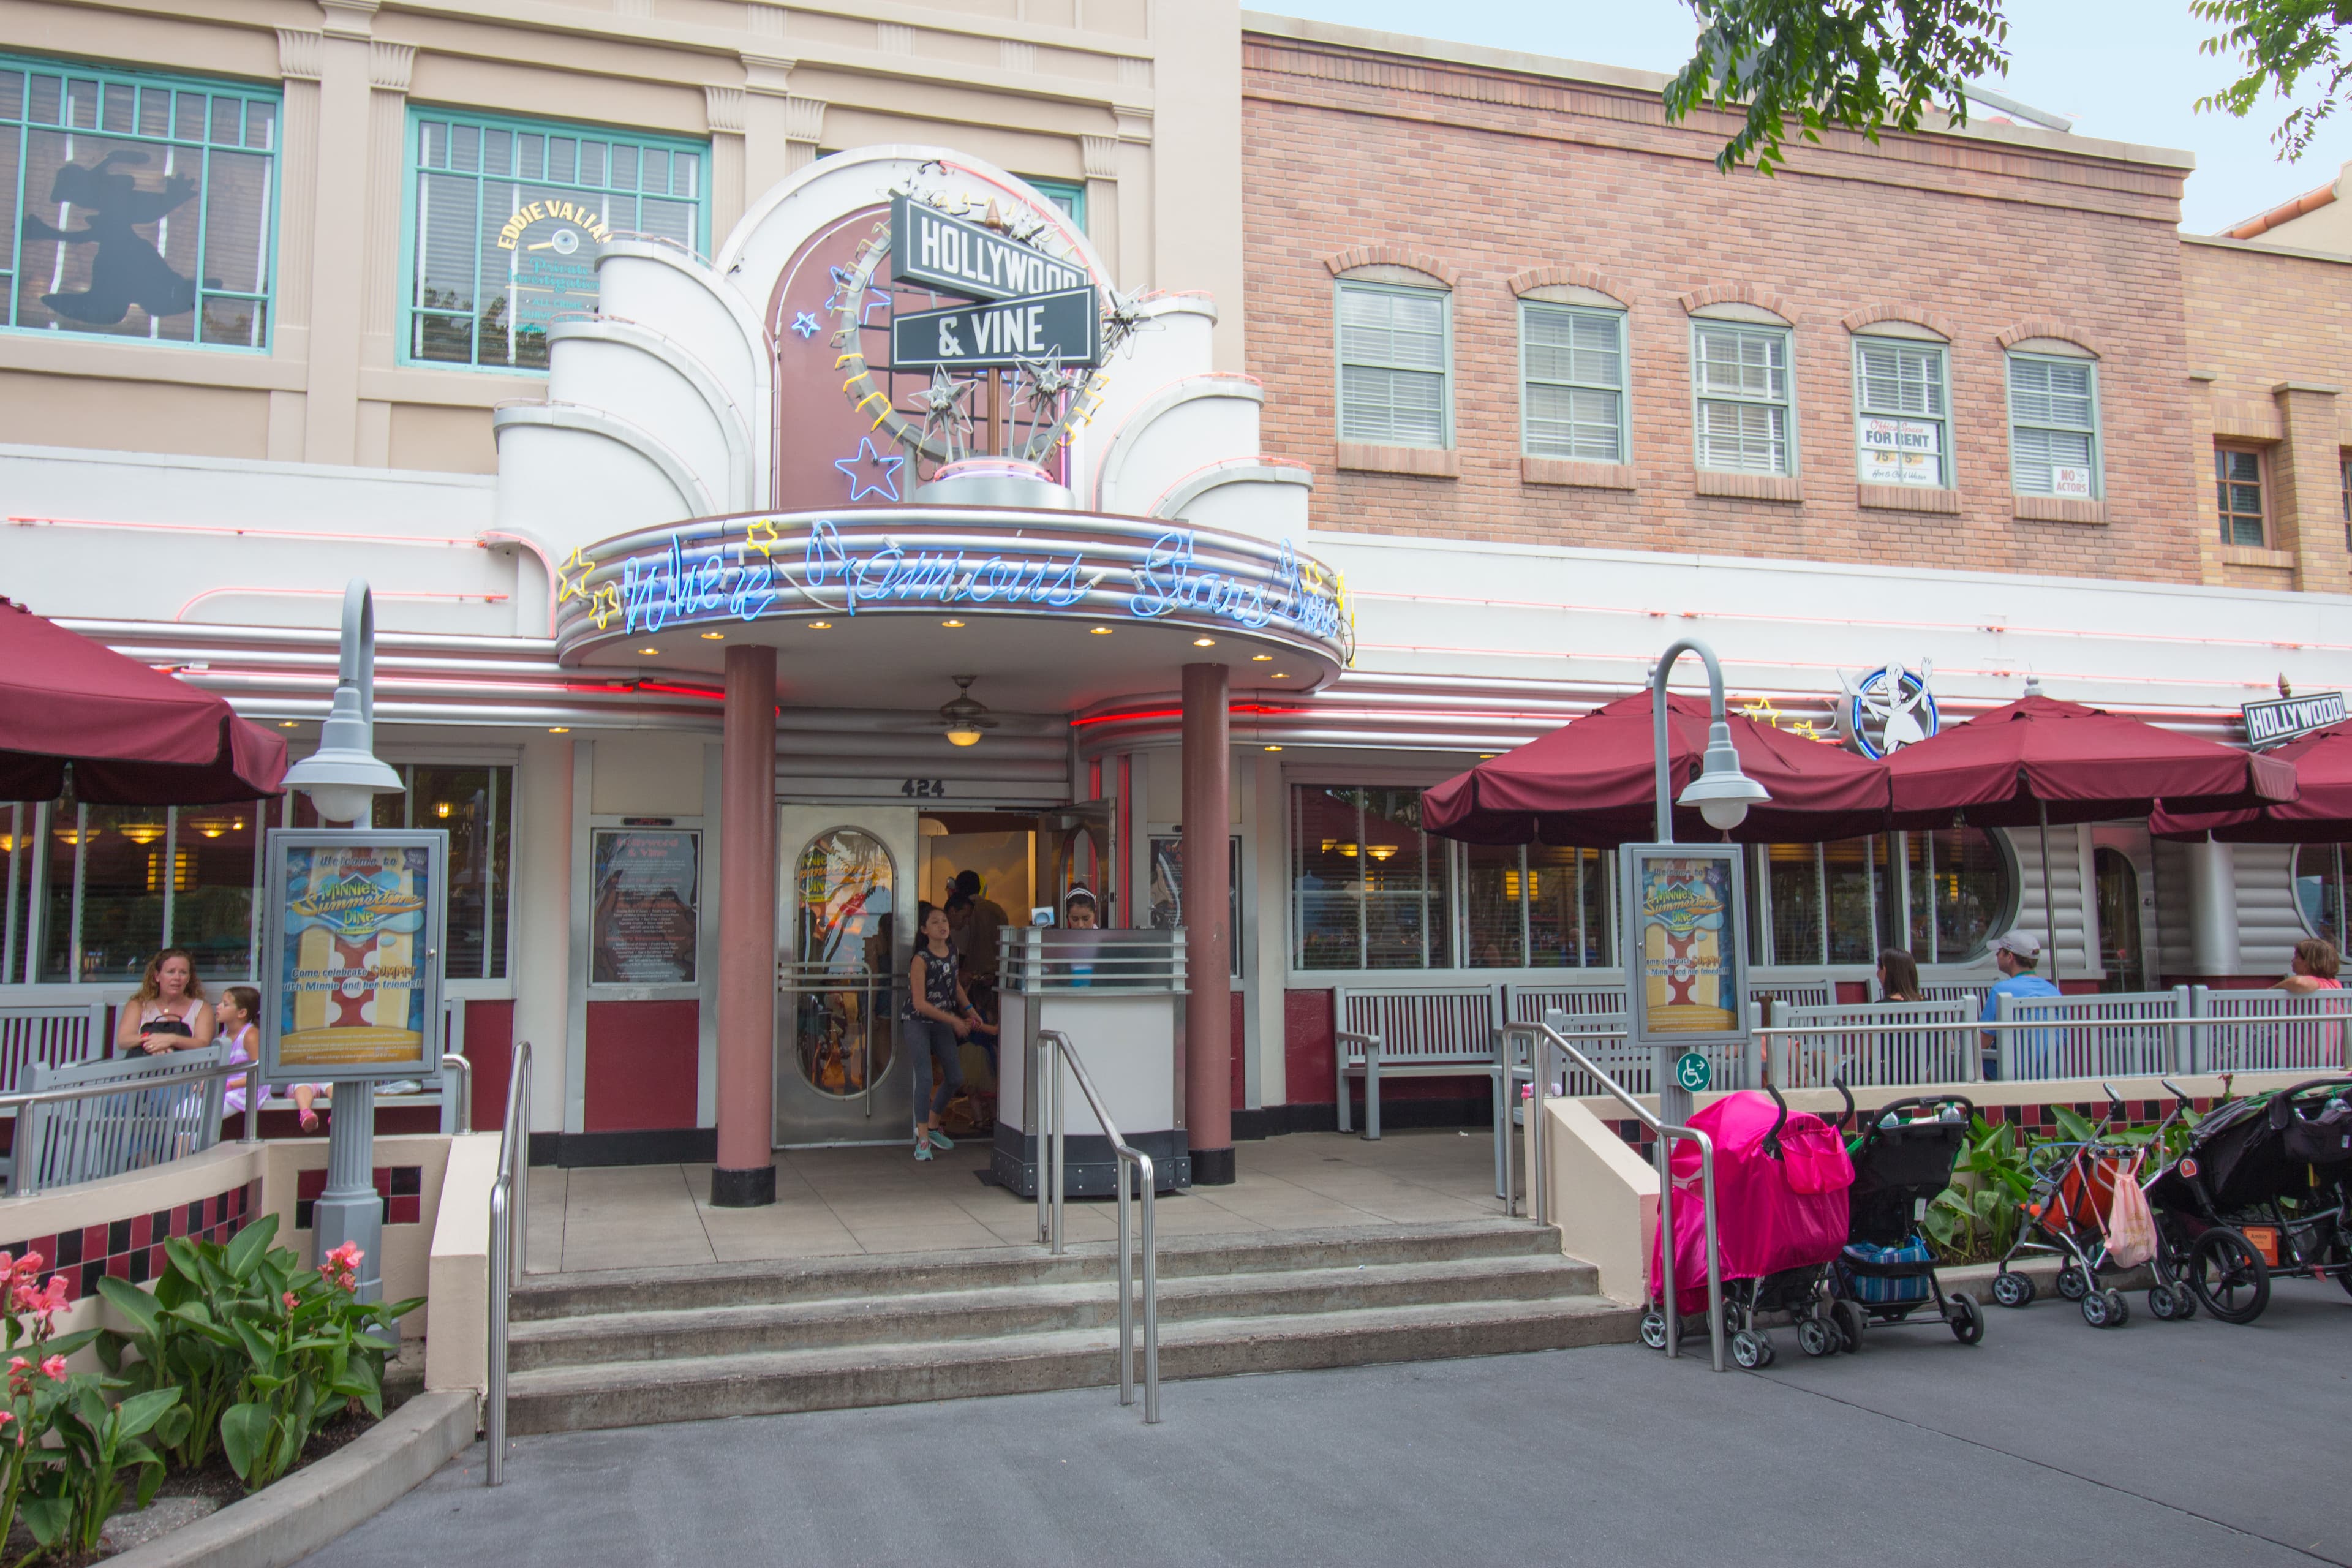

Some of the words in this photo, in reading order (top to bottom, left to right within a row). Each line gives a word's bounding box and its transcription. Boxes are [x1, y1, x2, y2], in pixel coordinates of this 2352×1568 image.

[497, 202, 545, 251] EDDIE
[545, 200, 613, 244] VALIA
[529, 257, 589, 275] Private
[554, 300, 582, 309] CRIME
[938, 317, 965, 356] &
[971, 306, 1044, 355] VINE
[1866, 430, 1891, 445] FOR
[1895, 432, 1929, 447] RENT
[2060, 470, 2075, 481] NO
[2057, 482, 2086, 493] ACTORS
[624, 533, 777, 635] Where
[806, 519, 1084, 616] Famous
[1129, 530, 1270, 628] Stars
[2248, 698, 2343, 739] HOLLYWOOD
[901, 778, 944, 797] 424
[320, 855, 378, 867] Welcome
[383, 857, 398, 866] to
[1654, 868, 1690, 876] Welcome
[292, 890, 421, 916] Summertime
[292, 968, 320, 979] Come
[323, 968, 368, 978] celebrate
[306, 981, 340, 991] Minnie
[342, 981, 361, 990] and
[363, 981, 379, 990] her
